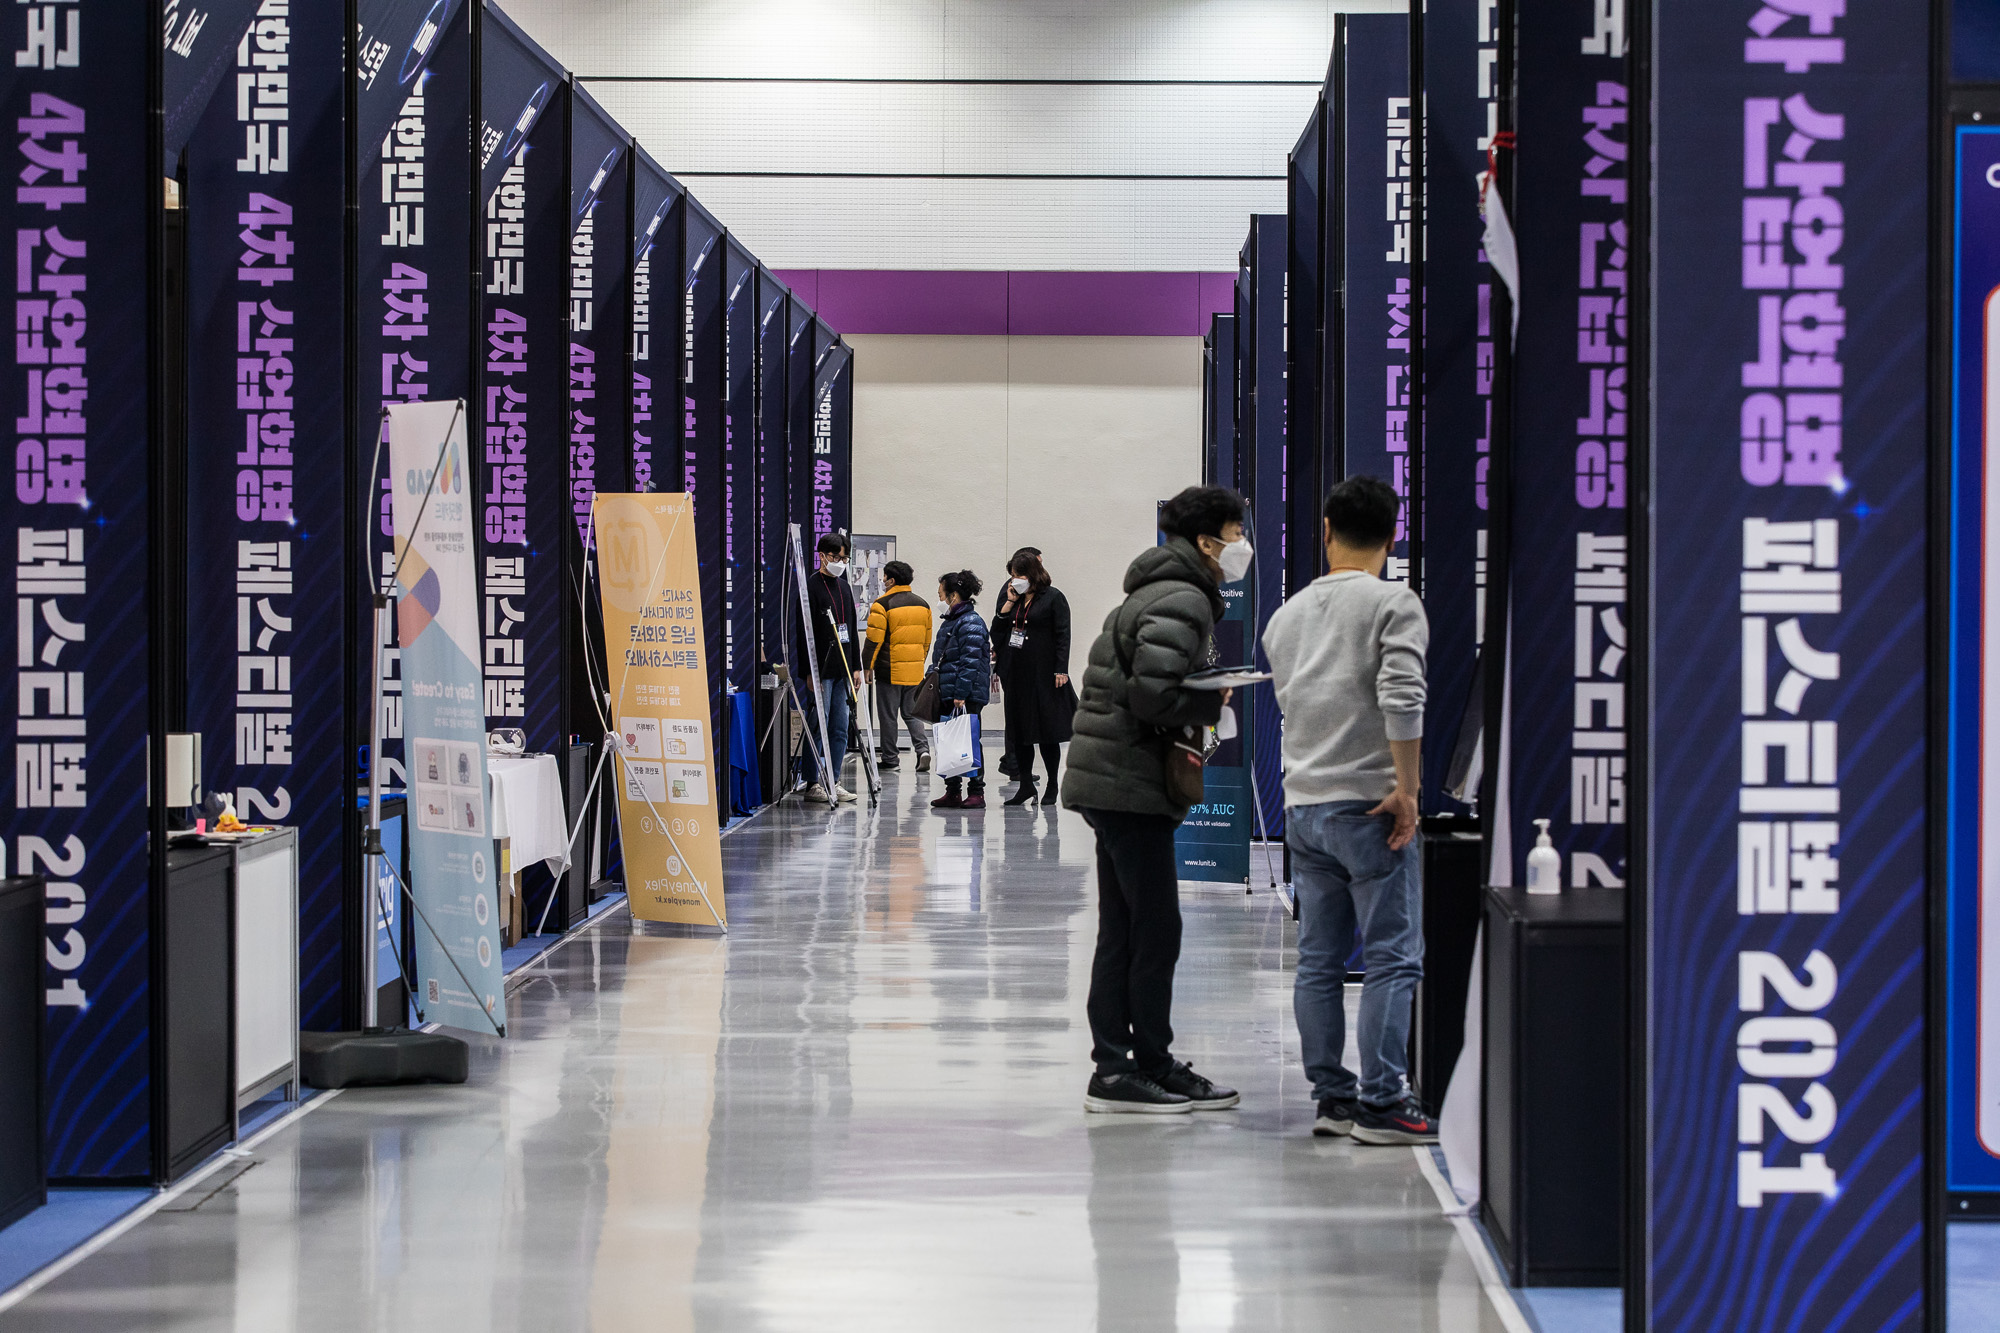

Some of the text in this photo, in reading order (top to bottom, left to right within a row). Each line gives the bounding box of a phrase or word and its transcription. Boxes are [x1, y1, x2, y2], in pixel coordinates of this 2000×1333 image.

[16, 92, 88, 211] 4차
[237, 193, 294, 287] 4차
[16, 226, 88, 506] 산업혁명
[382, 263, 429, 341] 4차
[487, 309, 528, 376] 4차
[1741, 93, 1846, 488] 산업혁명
[237, 299, 295, 523] 산업혁명
[486, 385, 528, 545] 산업혁명
[16, 528, 87, 808] 페스티벌
[236, 541, 293, 765] 페스티벌
[484, 556, 526, 717] 페스티벌
[1738, 517, 1841, 915] 페스티벌
[1211, 804, 1235, 815] AUC
[1737, 950, 1839, 1208] 2021
